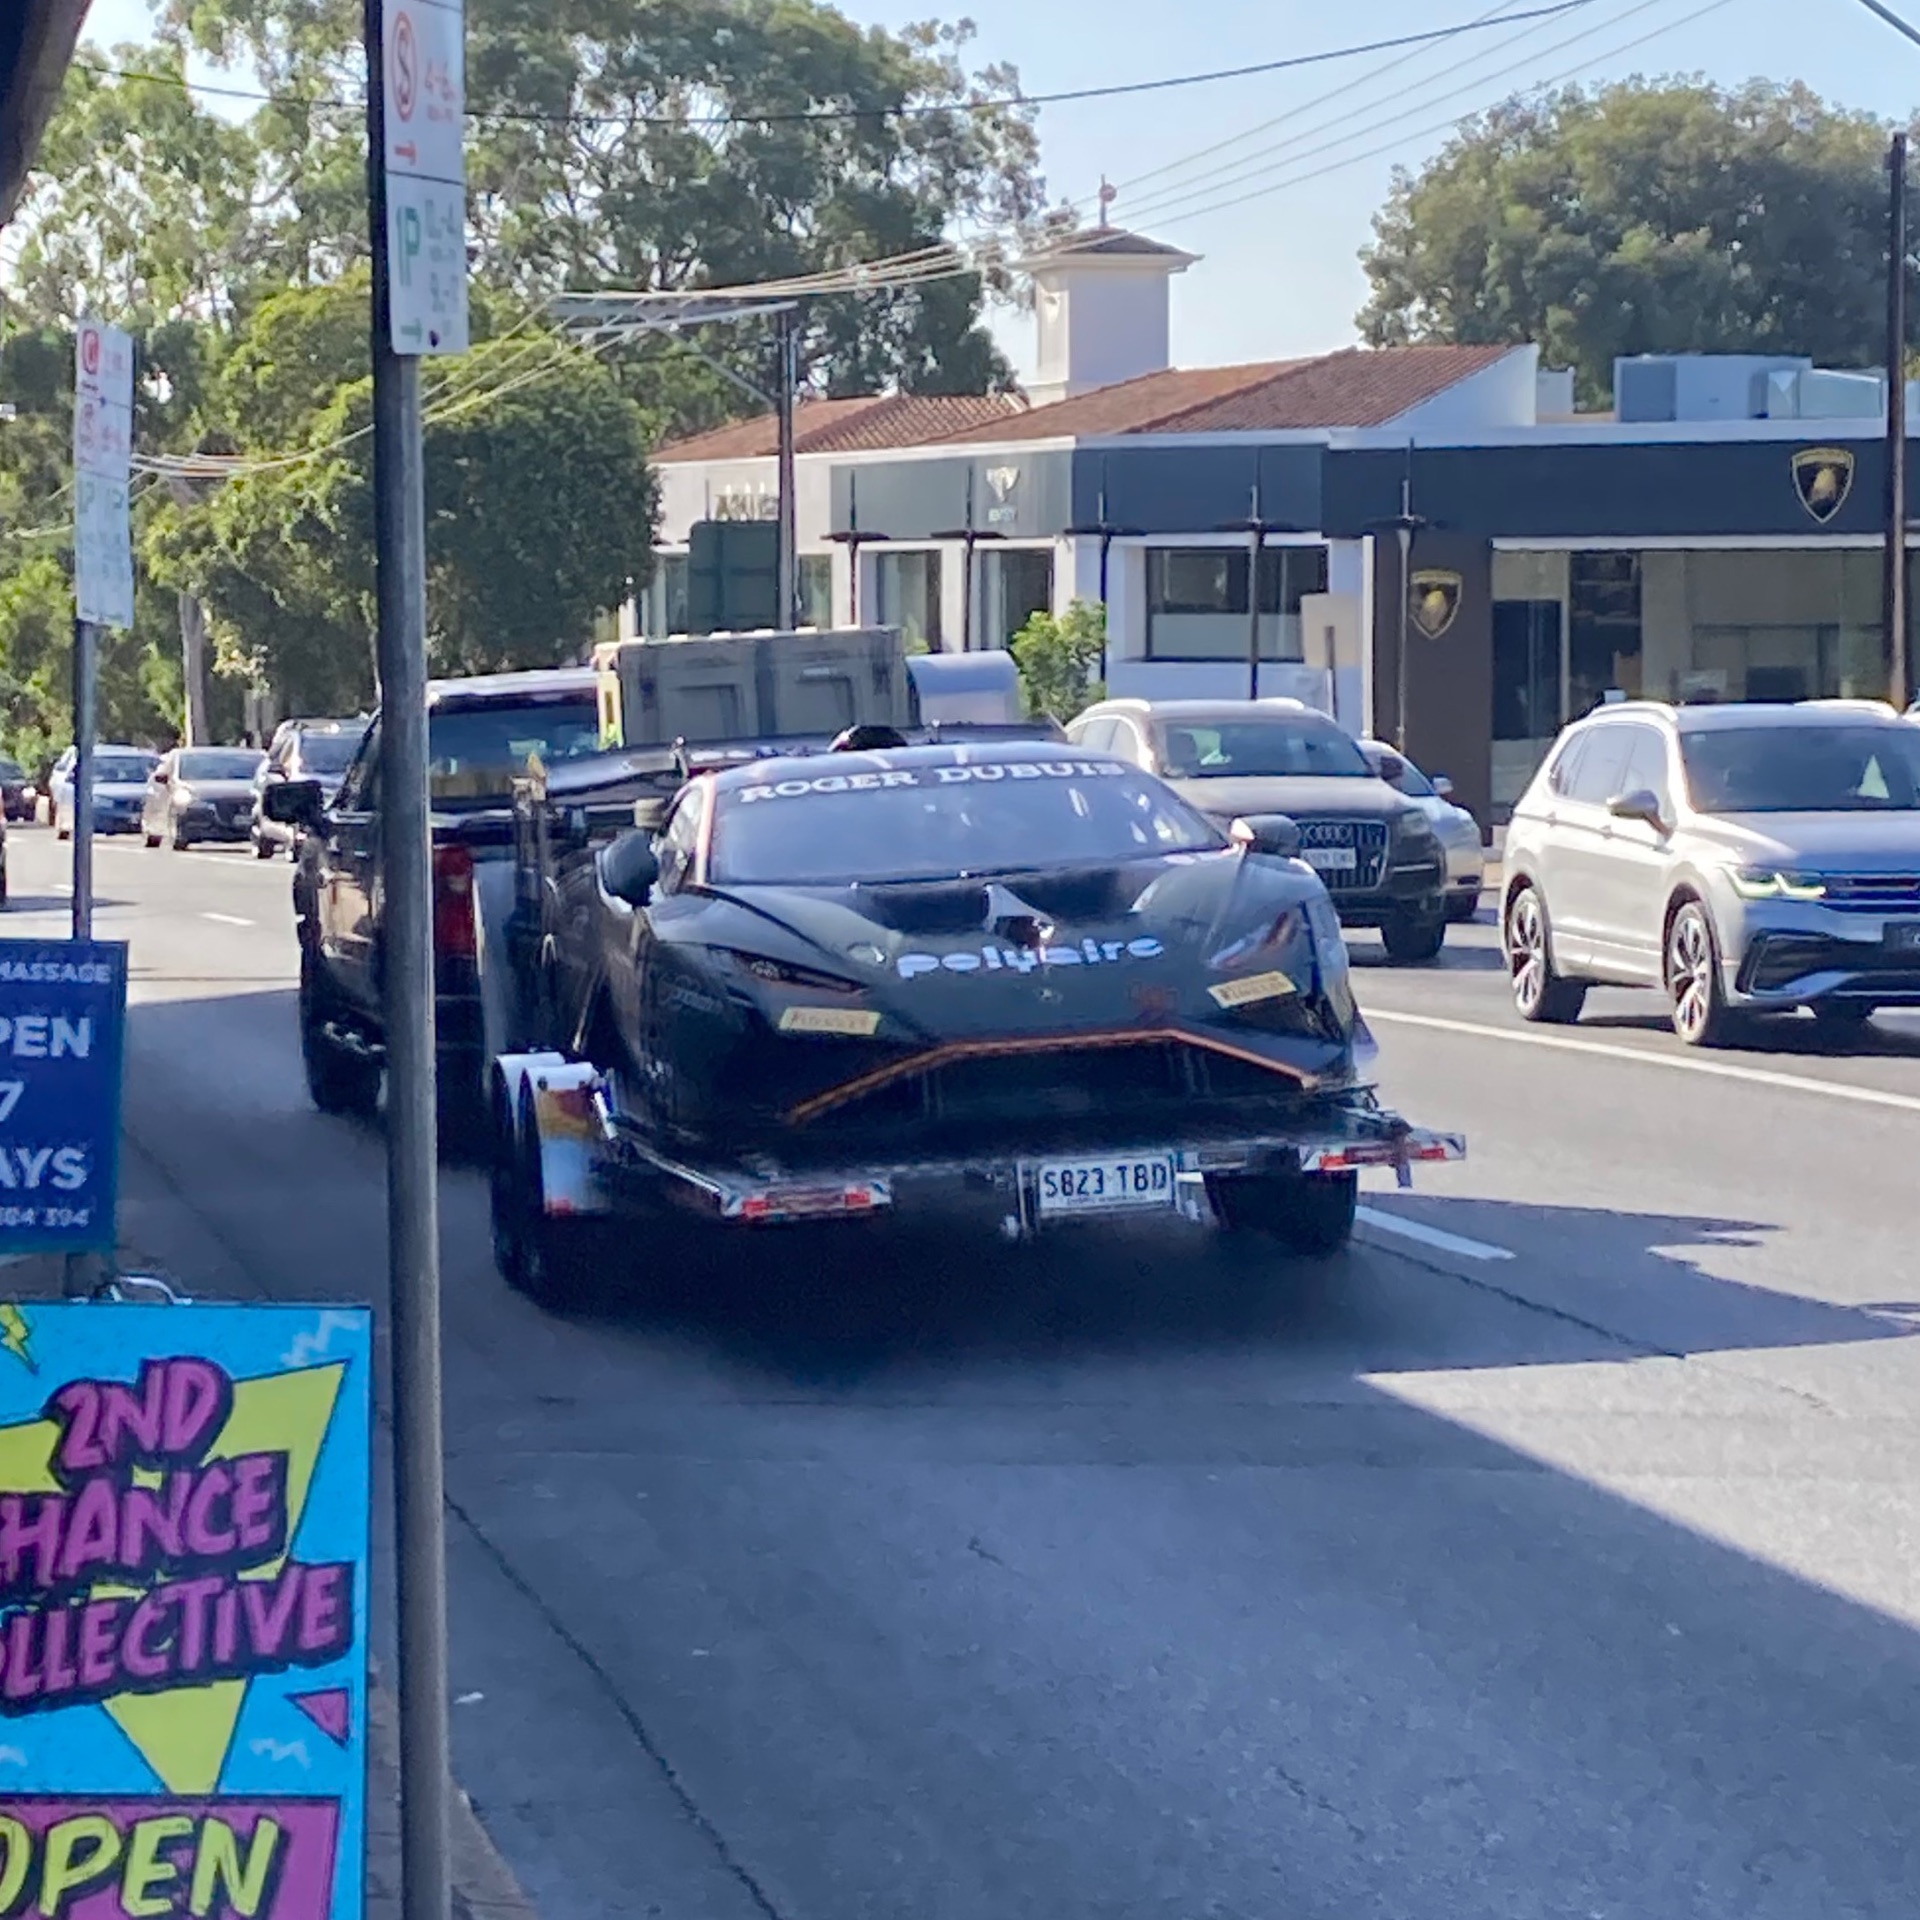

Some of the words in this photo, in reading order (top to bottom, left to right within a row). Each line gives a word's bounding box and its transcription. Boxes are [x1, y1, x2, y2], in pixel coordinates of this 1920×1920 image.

[740, 770, 919, 804] ROGER
[935, 760, 1126, 785] DUBUIS
[896, 936, 1165, 979] polyaire
[0, 1080, 25, 1123] 7
[1043, 1167, 1104, 1199] S823
[1116, 1162, 1168, 1192] TBD
[55, 1359, 223, 1470] 2ND
[0, 1453, 275, 1587] HANCE
[0, 1564, 341, 1698] LLECTIVE
